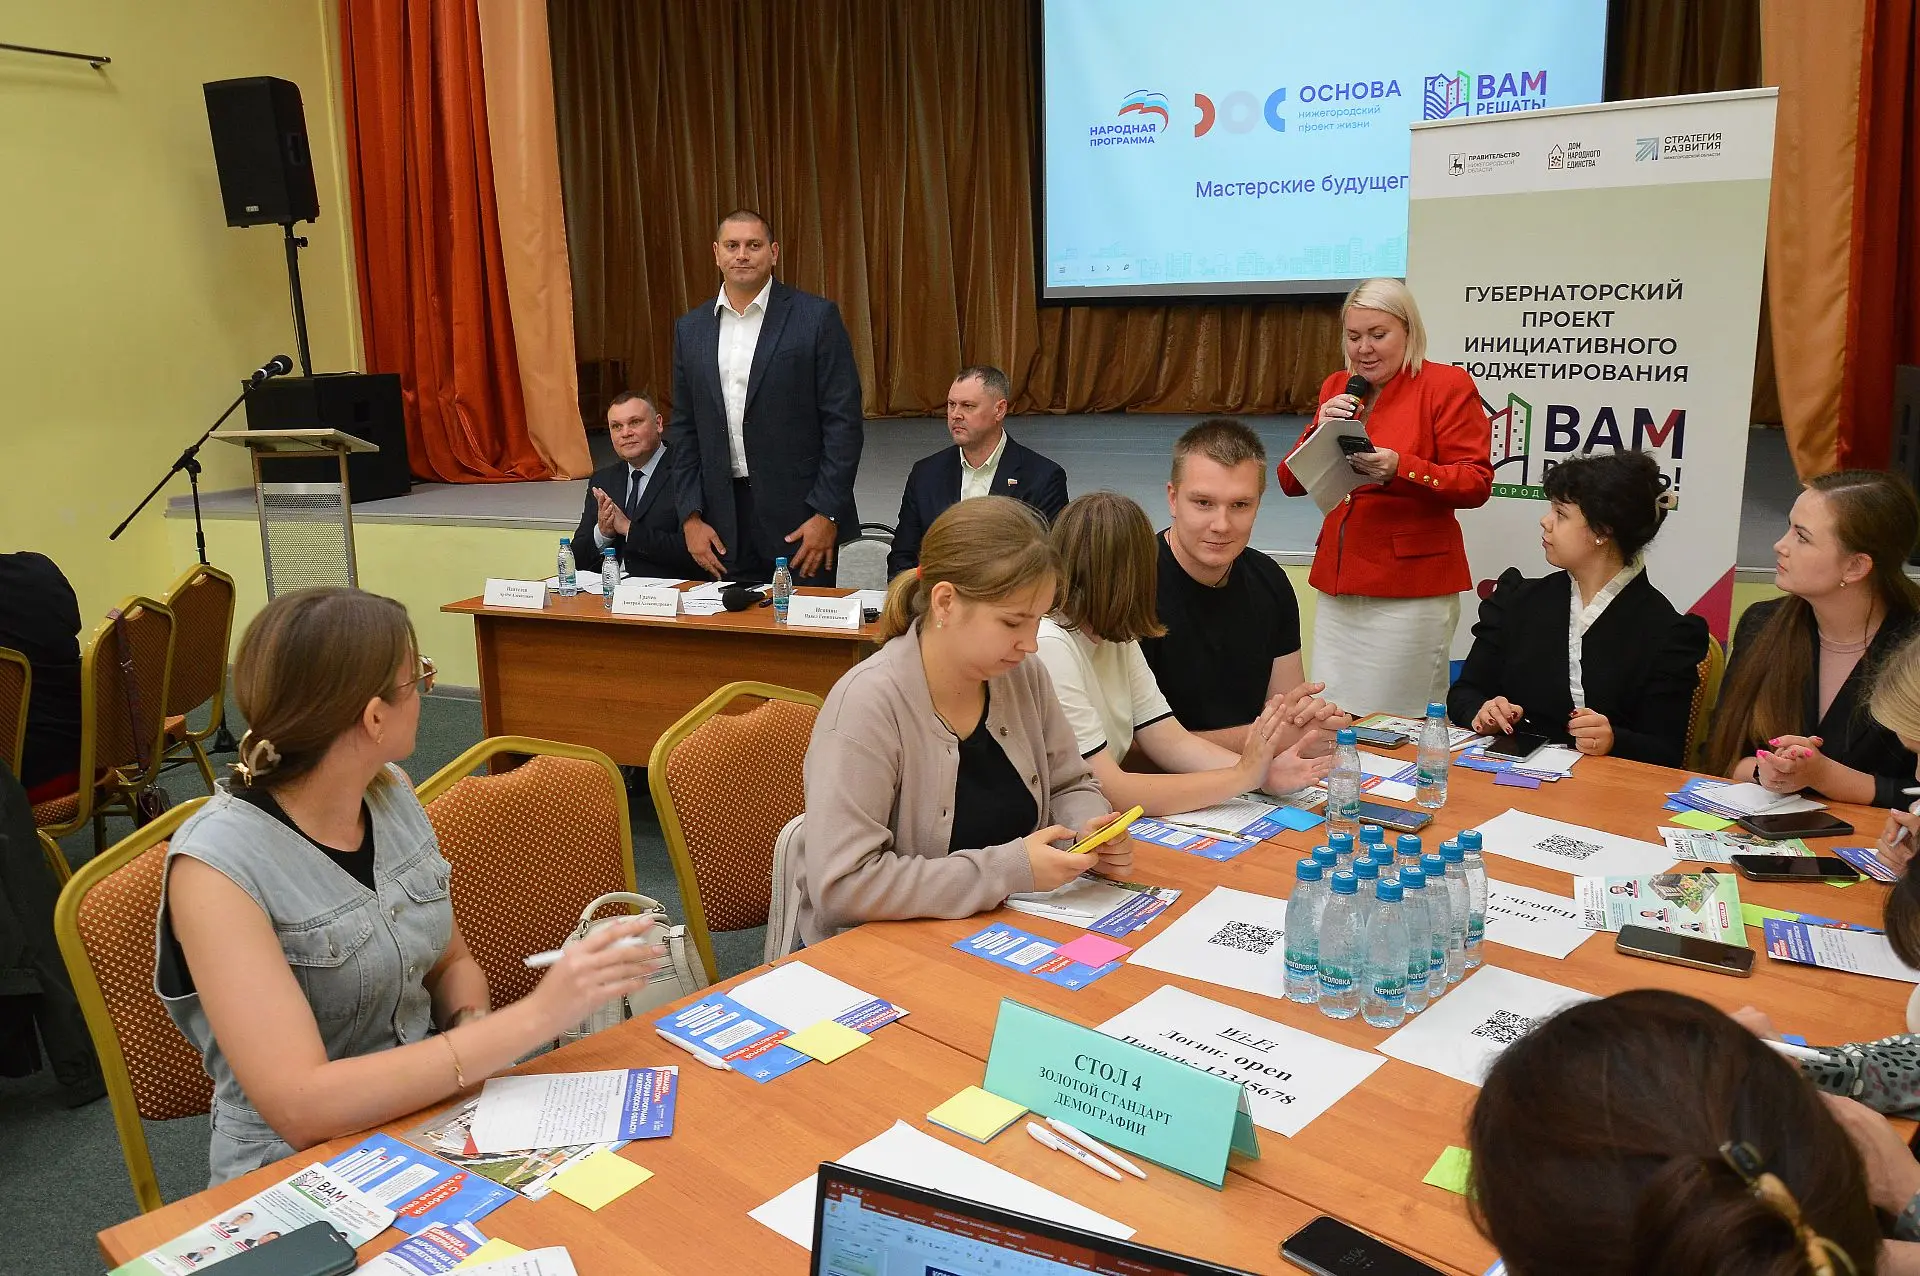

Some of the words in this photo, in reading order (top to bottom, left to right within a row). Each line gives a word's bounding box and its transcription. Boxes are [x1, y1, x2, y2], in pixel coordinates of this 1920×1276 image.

[1299, 80, 1401, 103] ОСНОВА
[1477, 70, 1547, 99] ВАМ
[1298, 105, 1380, 121] нижегородский
[1090, 123, 1156, 136] НАРОДНАЯ
[1298, 120, 1334, 134] проект
[1337, 119, 1370, 131] жизни
[1090, 134, 1155, 147] ПРОГРАММА
[1568, 142, 1581, 151] ДОМ
[1664, 132, 1722, 144] СТРАТЕГИЯ
[1664, 142, 1721, 153] РАЗВИТИЯ
[1468, 151, 1520, 161] ПРАВИТЕЛЬСТВО
[1567, 149, 1601, 159] НАРОДНОГО
[1567, 158, 1597, 169] ЕДИНСТВА
[1196, 178, 1315, 199] Мастерские
[1465, 279, 1683, 302] ГУБЕРНАТОРСКИЙ
[1522, 311, 1615, 328] ПРОЕКТ
[1464, 337, 1677, 356] ИНИЦИАТИВНОГО
[1544, 404, 1686, 459] ВАМ
[1217, 1027, 1279, 1053] Wi-Fi
[1159, 1030, 1228, 1058] Логин:
[1234, 1056, 1292, 1081] open
[1074, 1054, 1129, 1087] СТОЛ
[1131, 1075, 1142, 1091] 4
[1039, 1066, 1099, 1098] ЗОЛОТОЙ
[1101, 1091, 1173, 1125] СТАНДАРТ
[1054, 1092, 1147, 1136] ДЕМОГРАФИИ
[317, 1181, 348, 1203] ВАМ
[413, 1191, 449, 1215] заботой
